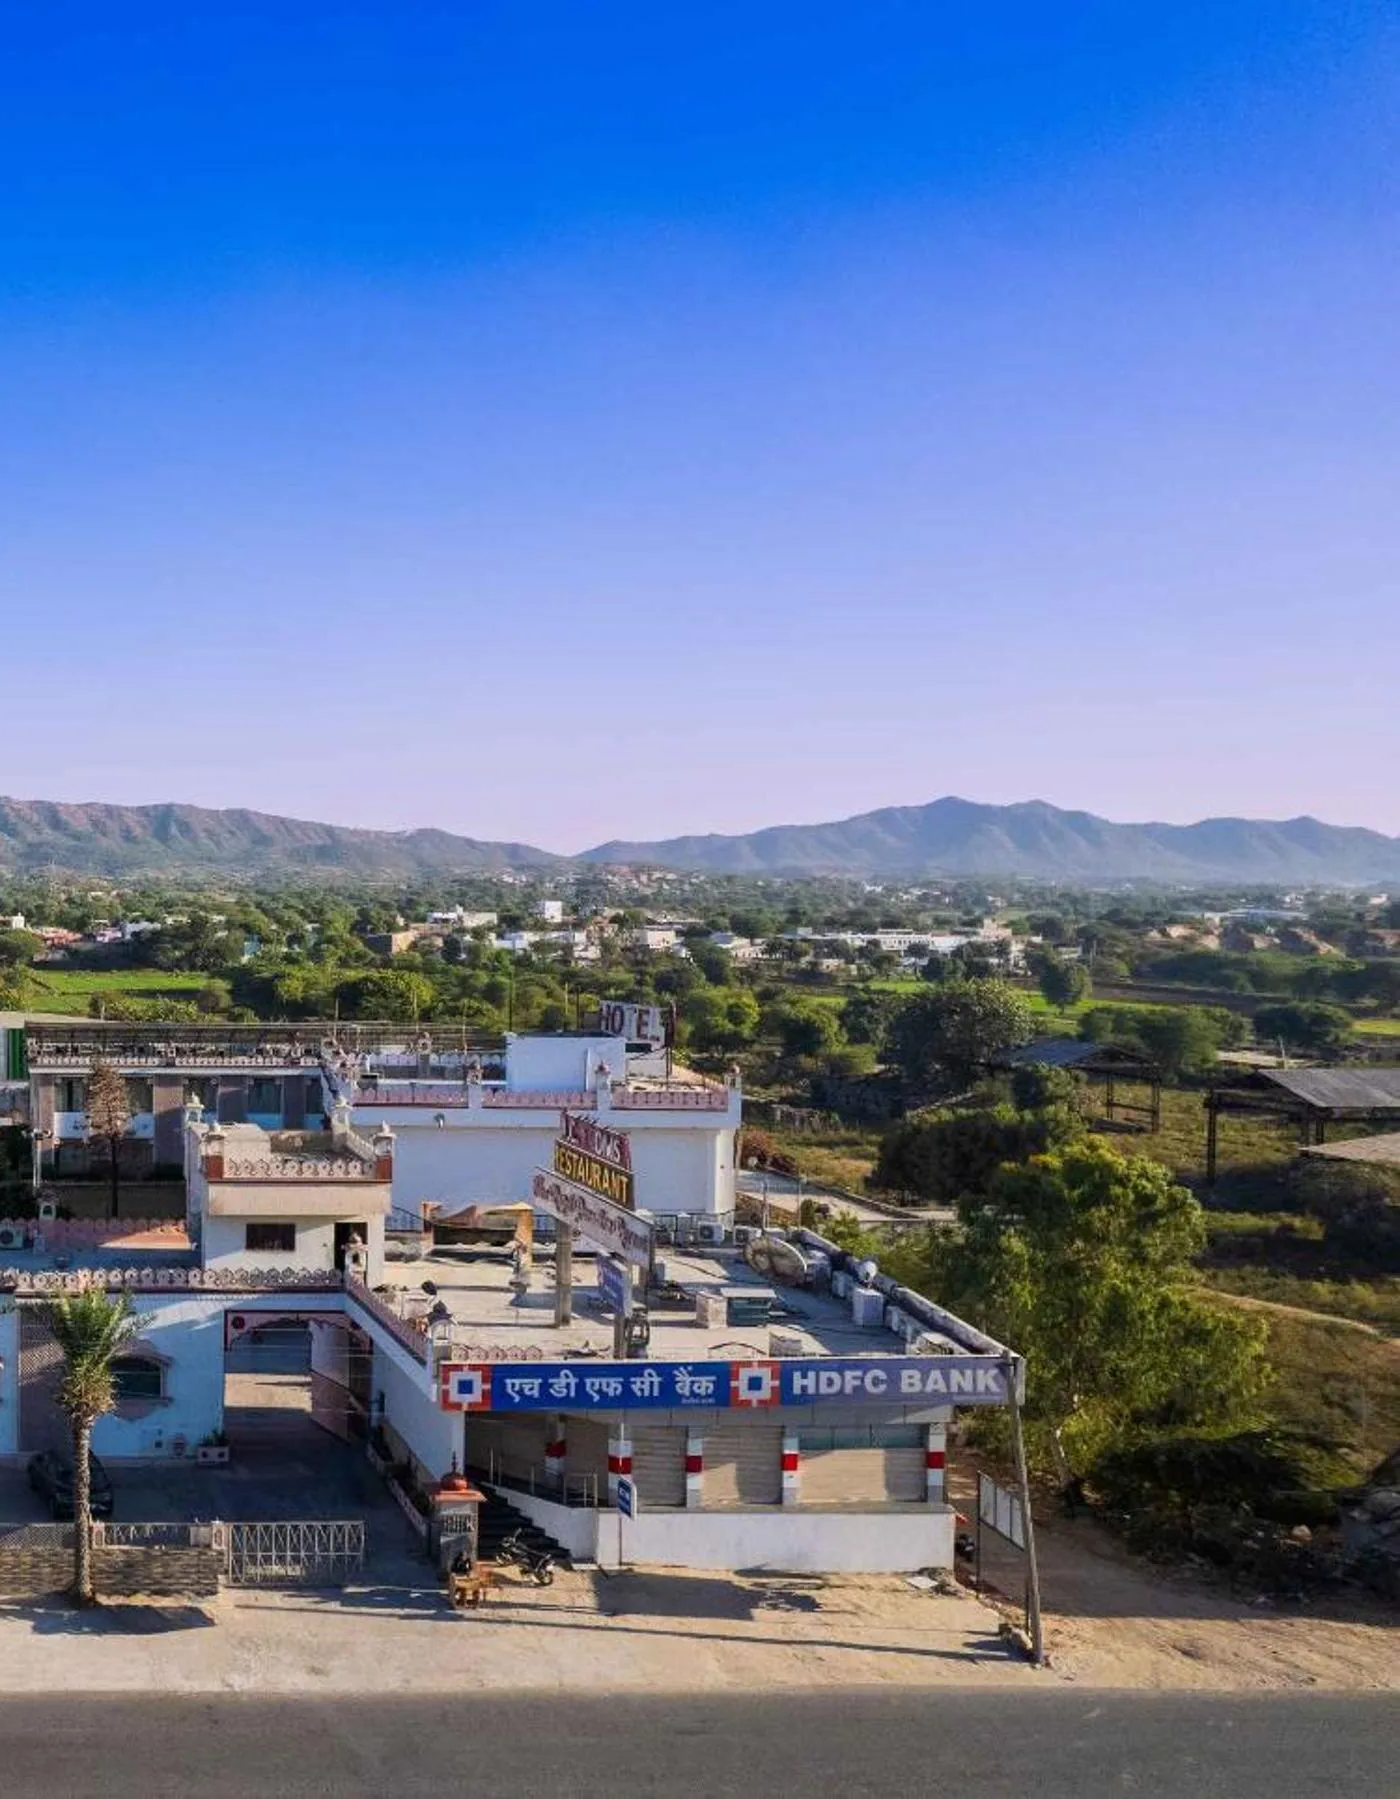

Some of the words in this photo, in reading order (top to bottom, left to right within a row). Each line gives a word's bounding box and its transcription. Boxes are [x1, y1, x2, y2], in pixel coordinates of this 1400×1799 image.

[504, 1377, 542, 1403] एच
[548, 1369, 579, 1398] डी
[584, 1376, 625, 1402] एफ
[629, 1368, 662, 1397] सी
[672, 1366, 717, 1397] बैंक
[792, 1368, 887, 1395] HDFC
[900, 1368, 1001, 1394] BANK
